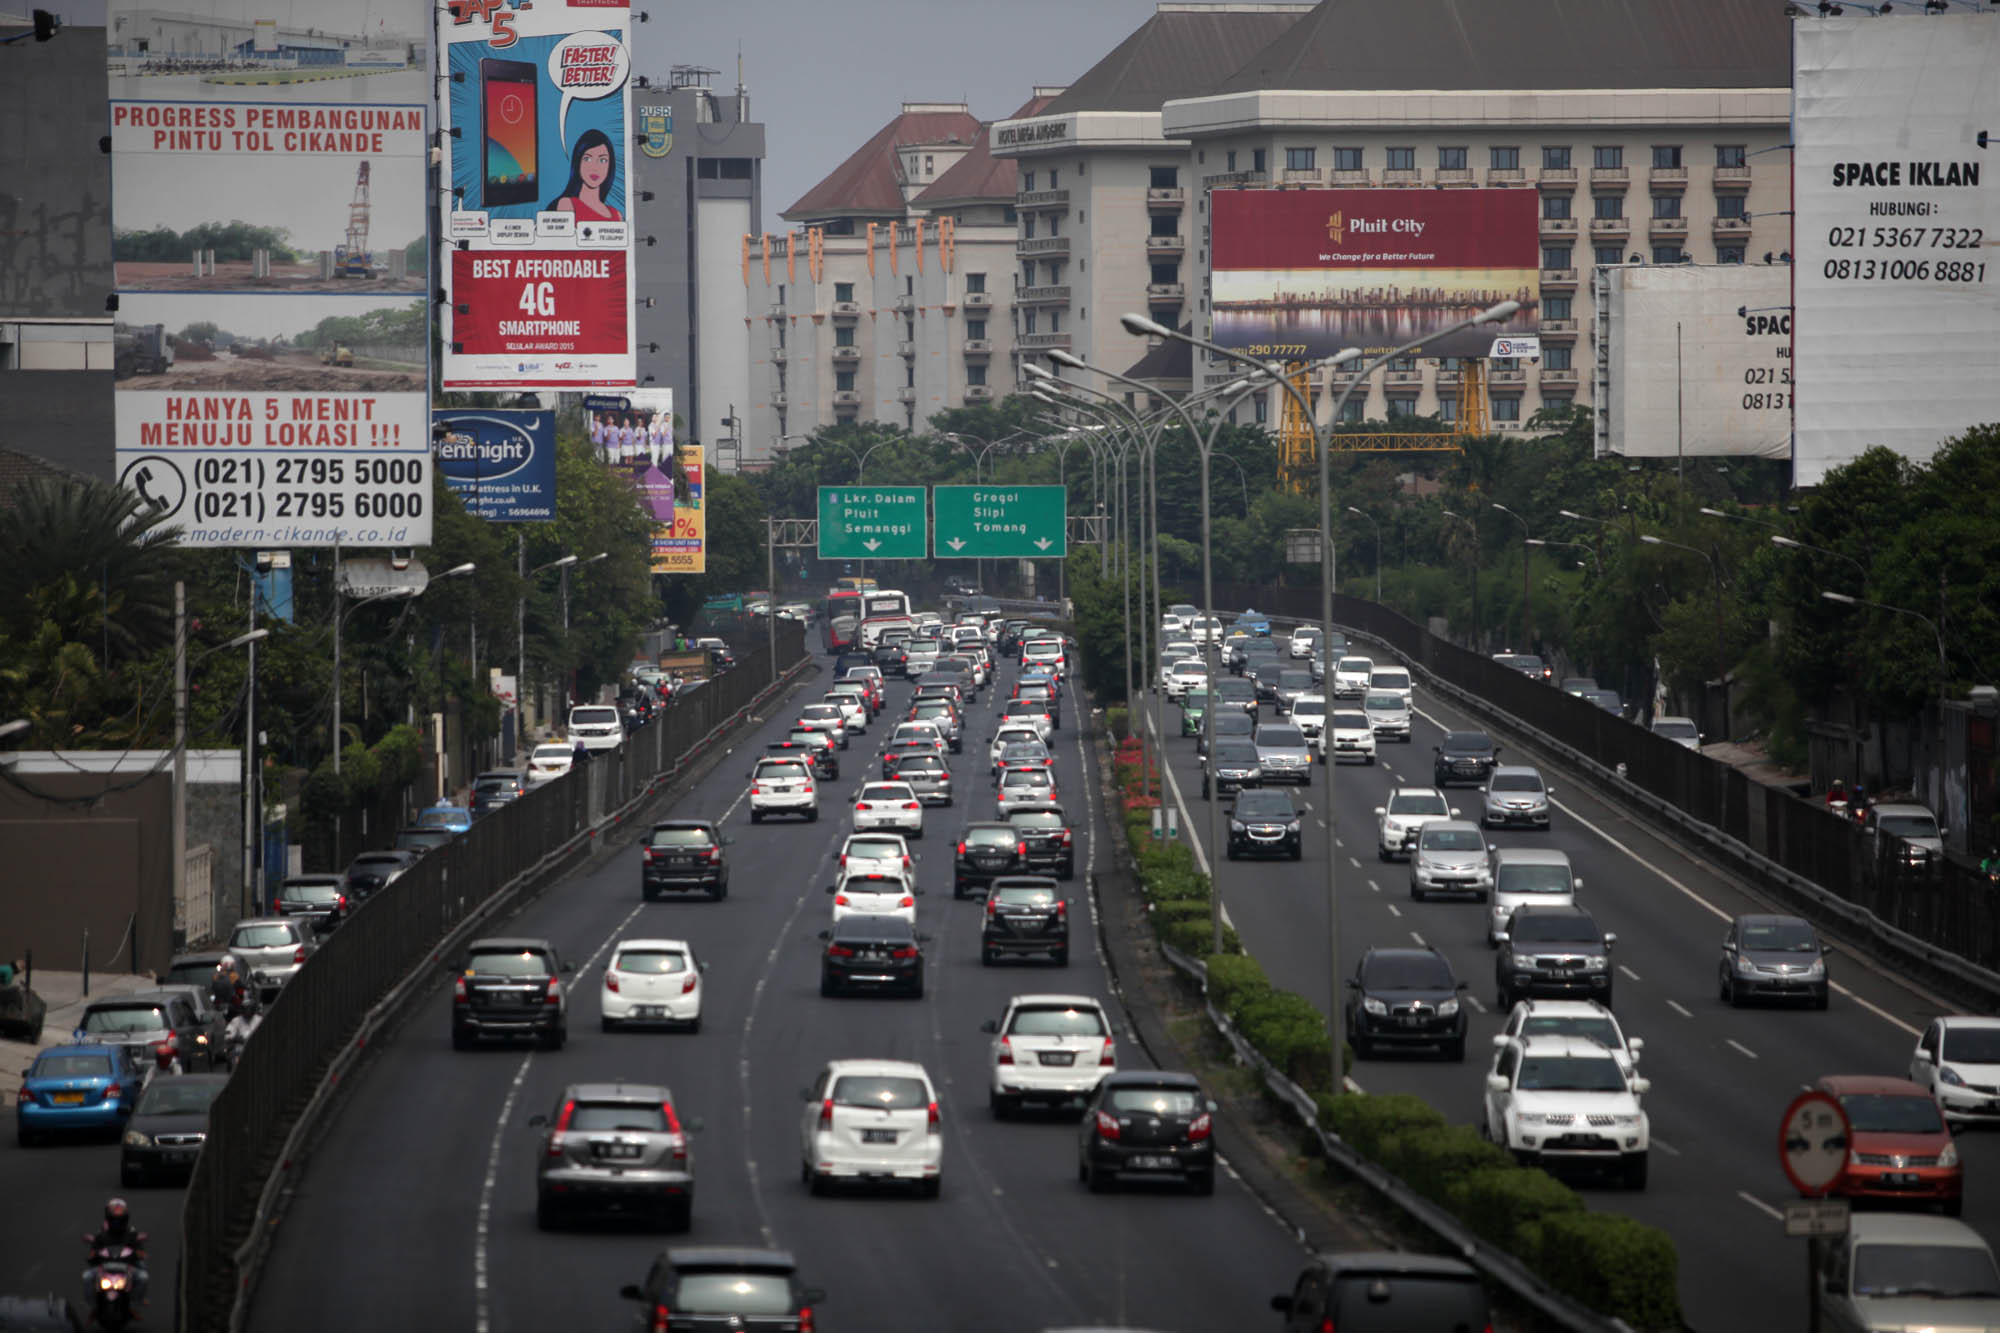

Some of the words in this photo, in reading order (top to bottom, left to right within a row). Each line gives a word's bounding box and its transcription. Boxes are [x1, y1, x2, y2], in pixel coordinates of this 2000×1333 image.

[489, 12, 517, 46] 5
[564, 46, 617, 65] FASTER!
[564, 65, 615, 83] BETTER!
[114, 106, 236, 128] PROGRESS
[246, 108, 422, 131] PEMBANGUNAN
[154, 130, 222, 151] PINTU
[232, 131, 274, 152] TOL
[284, 132, 383, 153] CIKANDE
[1832, 162, 1901, 187] SPACE
[1909, 162, 1979, 186] IKLAN
[1350, 218, 1388, 233] Pluit
[1392, 218, 1425, 237] City
[1828, 227, 1866, 247] 021
[1873, 227, 1926, 248] 5367
[1929, 228, 1984, 249] 7322
[1319, 253, 1331, 261] We
[1332, 253, 1361, 262] Change
[1362, 253, 1374, 262] for
[1383, 253, 1407, 261] Better
[1409, 252, 1435, 261] Future
[473, 259, 511, 278] BEST
[515, 259, 610, 278] AFFORDABLE
[1823, 259, 1929, 280] 08131006
[1934, 262, 1986, 282] 8881
[519, 281, 556, 316] 4G
[499, 320, 580, 336] SMARTPHONE
[1746, 315, 1790, 335] SPAC
[535, 342, 558, 350] AWARD
[559, 342, 575, 350] 2015
[1249, 345, 1270, 355] 290
[1273, 345, 1307, 355] 77777
[1745, 368, 1775, 384] 021
[166, 397, 253, 421] HANYA
[265, 398, 280, 421] 5
[292, 398, 376, 421] MENIT
[140, 422, 252, 446] MENUJU
[265, 423, 357, 446] LOKASI
[370, 424, 401, 447] !!!
[194, 458, 266, 490] (021)
[275, 459, 344, 485] 2795
[355, 459, 423, 485] 5000
[194, 491, 266, 524] (021)
[275, 492, 344, 518] 2795
[355, 492, 423, 518] 6000
[875, 494, 916, 504] Dalam
[845, 508, 879, 519] Pluit
[138, 526, 408, 543] .modern-cikande.co.id
[845, 523, 912, 534] Semanggi
[974, 522, 1027, 534] Tomang
